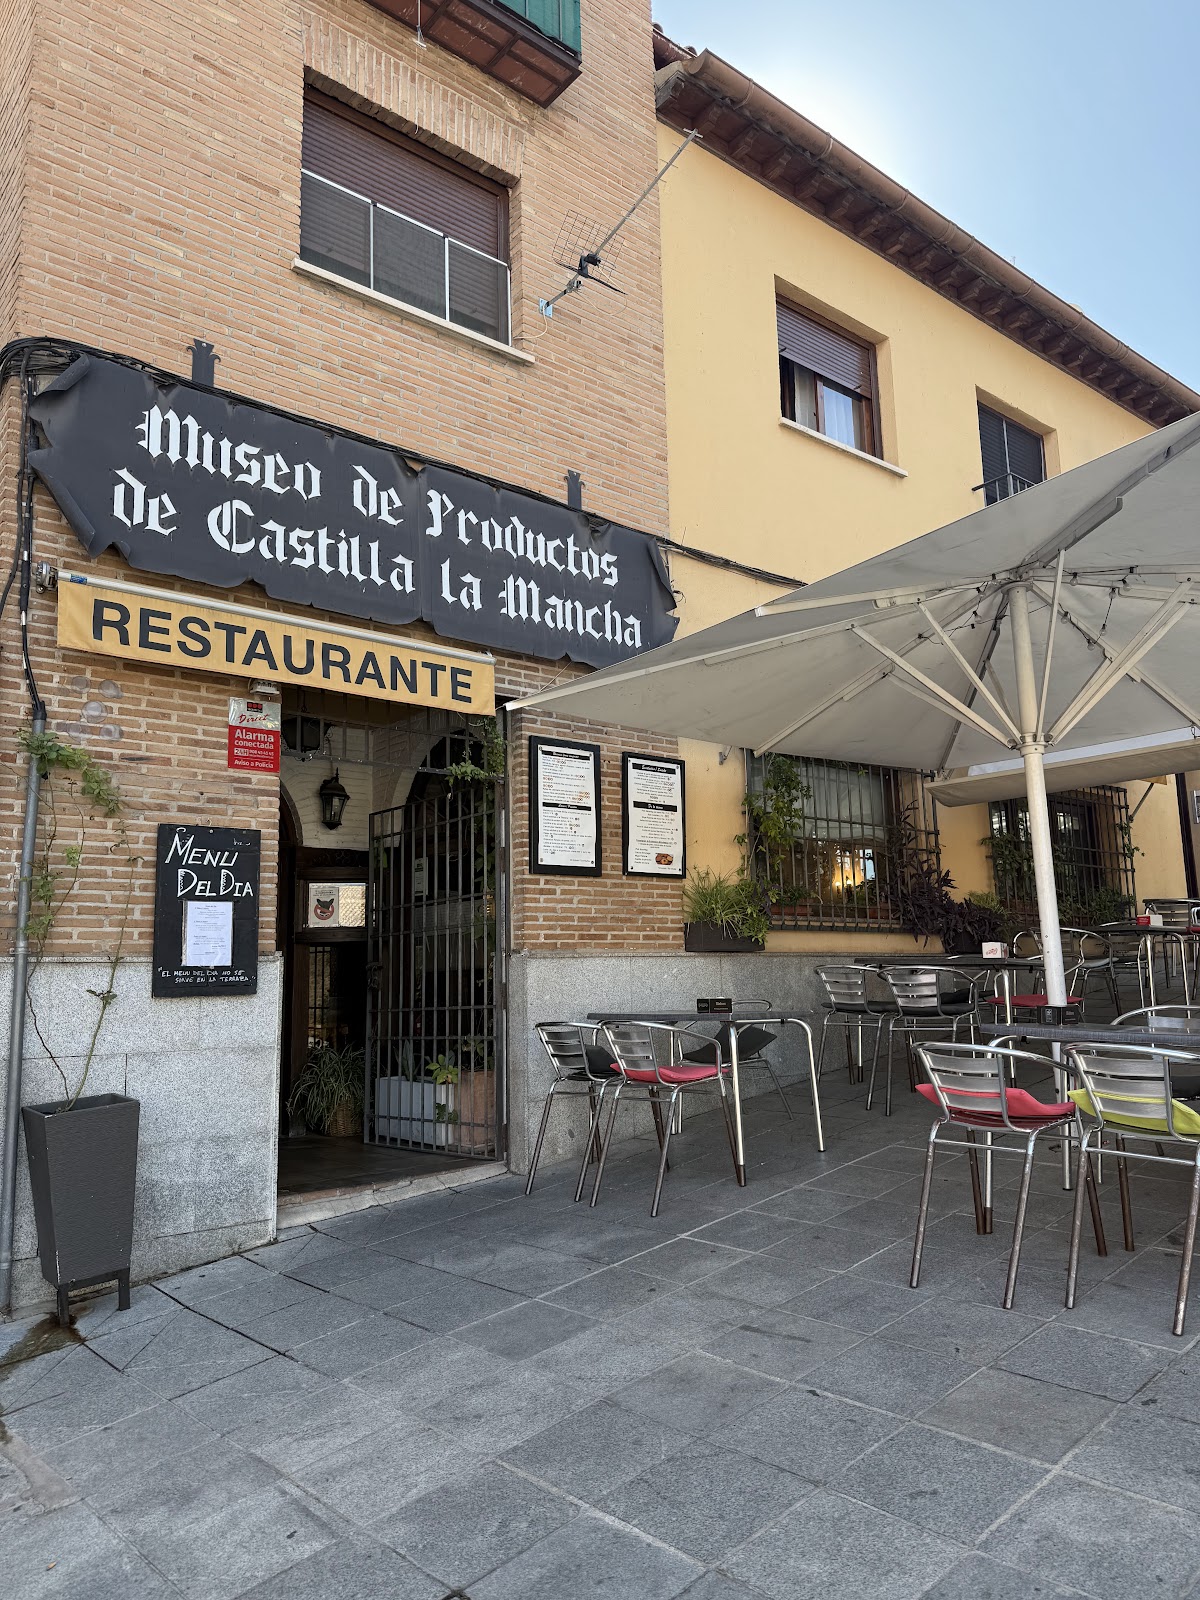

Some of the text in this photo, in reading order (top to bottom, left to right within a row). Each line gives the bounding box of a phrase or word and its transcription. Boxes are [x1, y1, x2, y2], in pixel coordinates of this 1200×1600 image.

[135, 405, 619, 587] Museo de Productos
[112, 467, 643, 649] de Castilla la Mancha
[92, 598, 473, 704] RESTAURANTE
[234, 728, 274, 742] Alarma
[234, 740, 274, 749] conectada
[165, 832, 239, 867] MENU
[177, 868, 253, 897] DEL DIA
